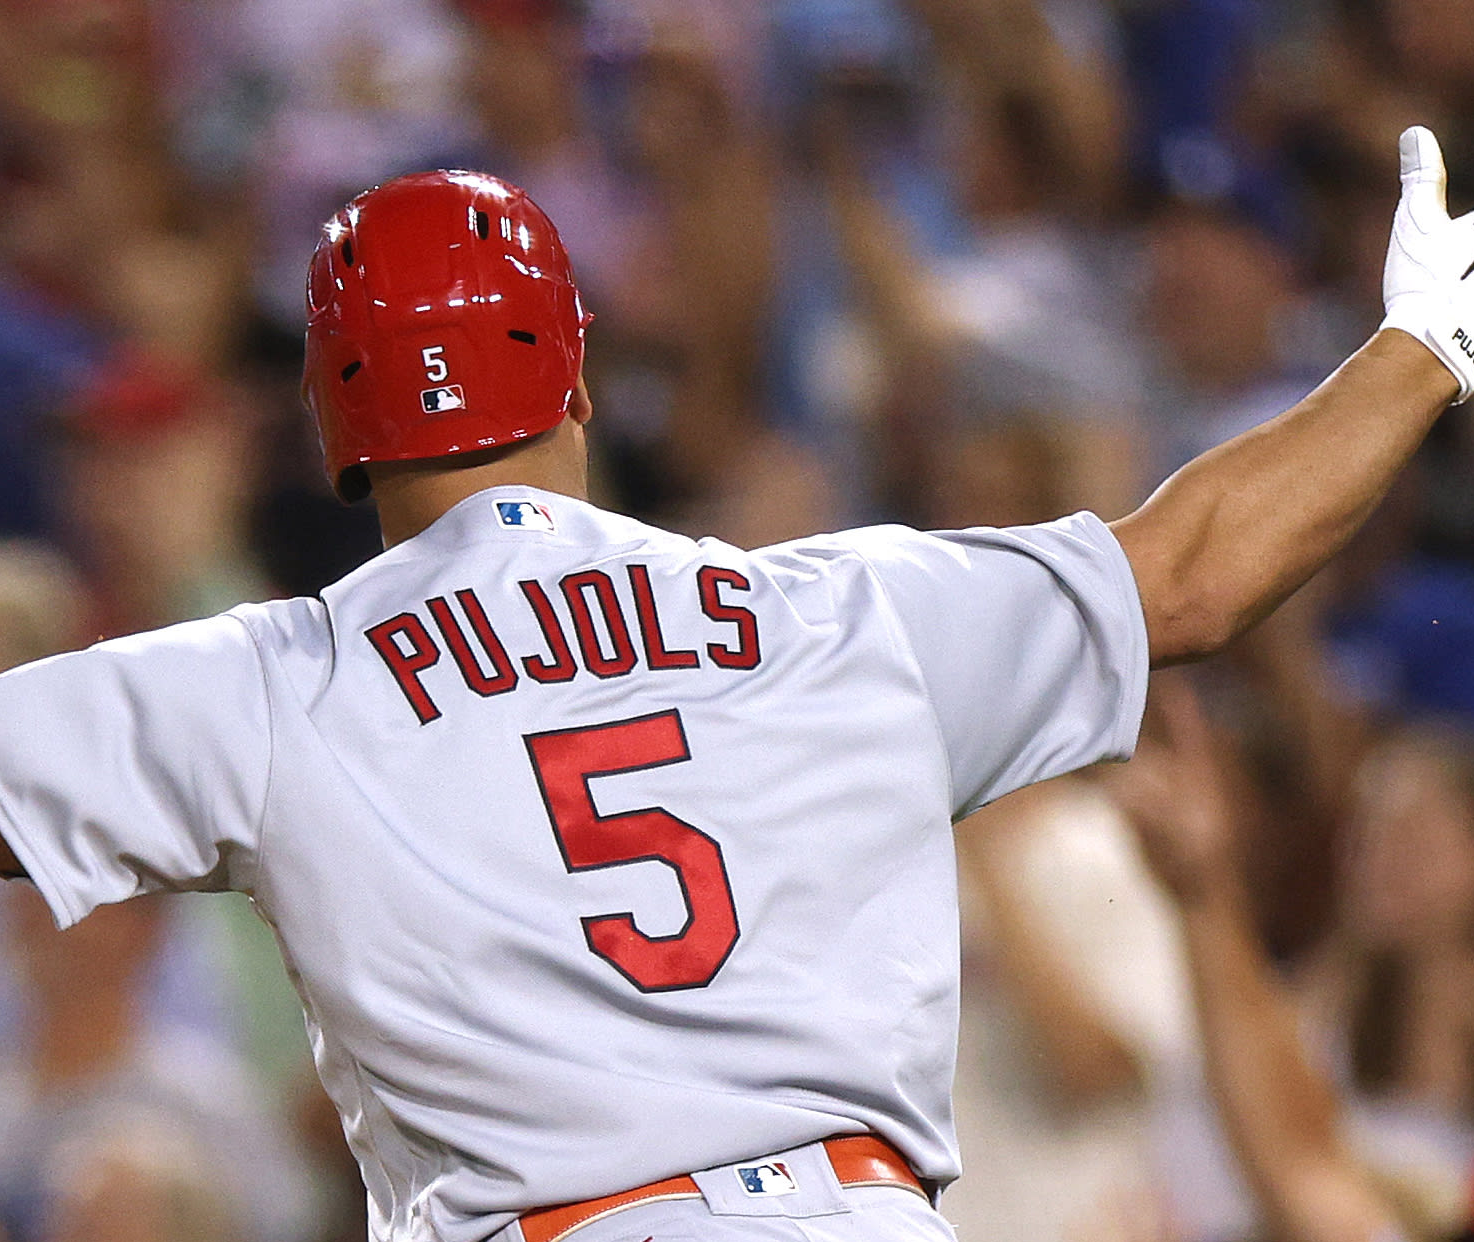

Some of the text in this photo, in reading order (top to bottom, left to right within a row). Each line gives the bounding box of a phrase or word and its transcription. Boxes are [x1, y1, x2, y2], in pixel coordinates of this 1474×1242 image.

[421, 345, 449, 383] 5
[364, 563, 763, 727] PUJOLS
[521, 707, 742, 994] 5
